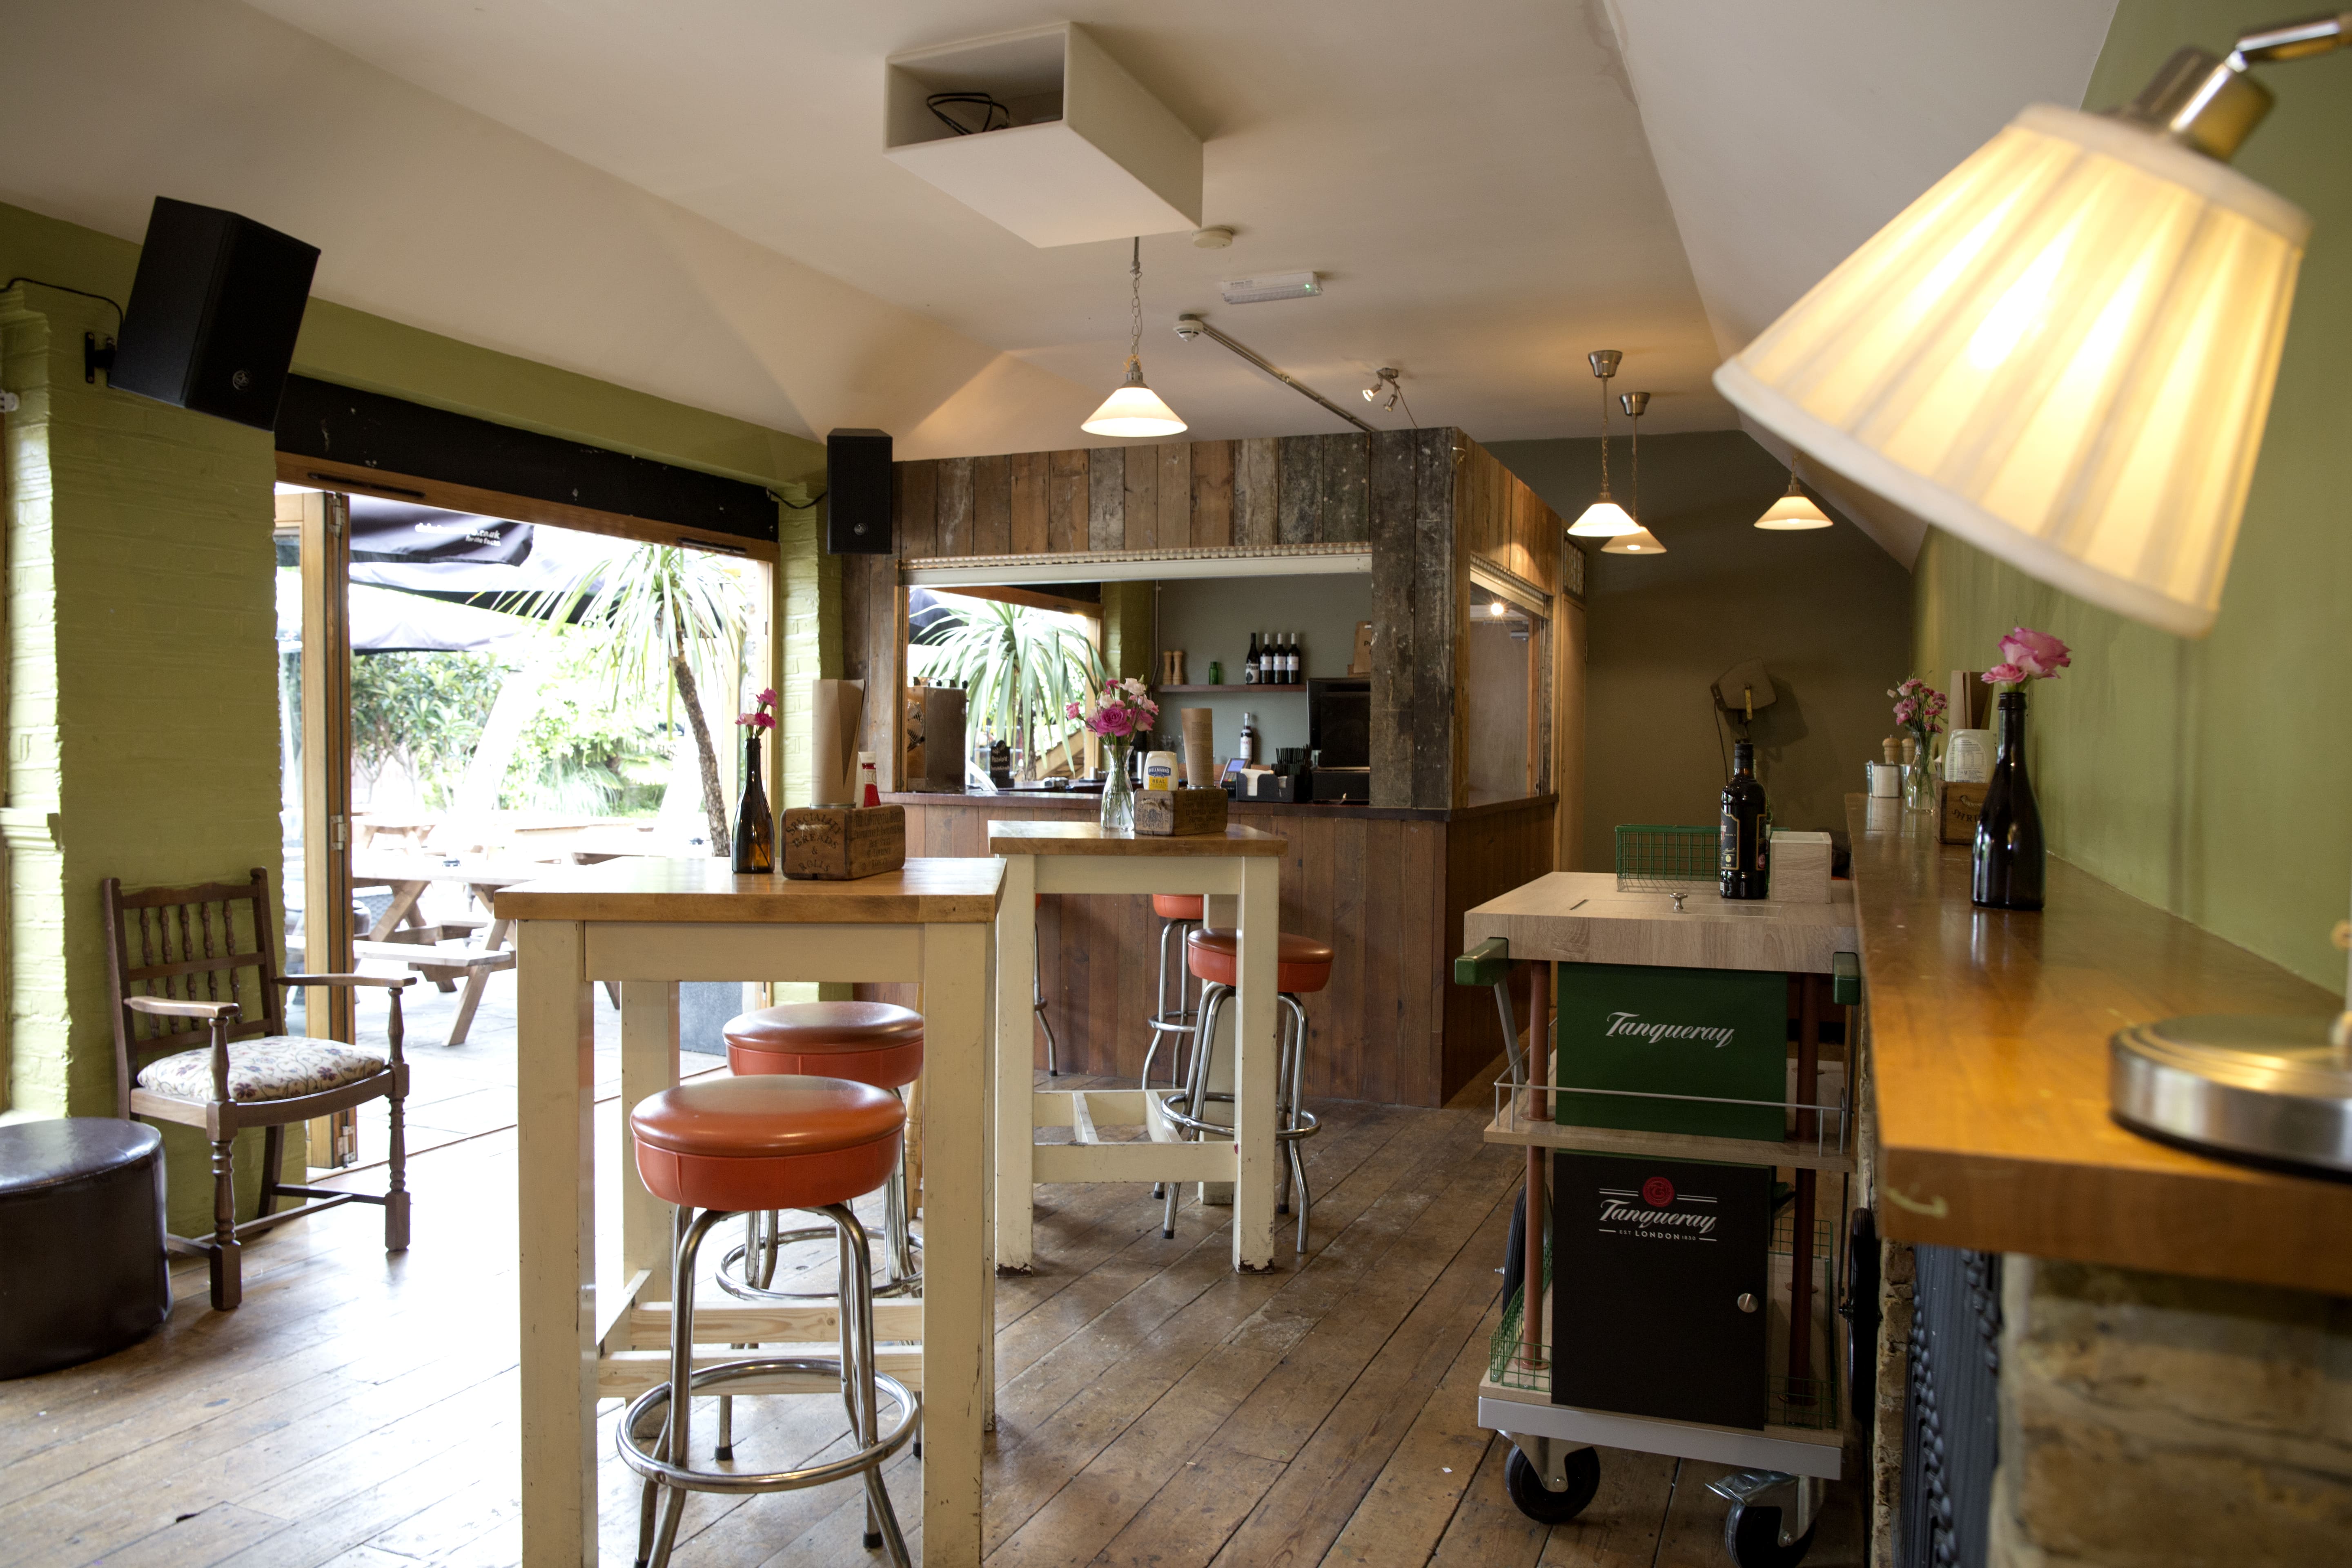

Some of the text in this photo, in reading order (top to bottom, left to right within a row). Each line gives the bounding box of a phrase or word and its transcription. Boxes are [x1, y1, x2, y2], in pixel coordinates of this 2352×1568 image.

[792, 833, 838, 849] BREADS
[812, 846, 818, 855] &
[798, 860, 830, 872] ROLLS
[1605, 1011, 1735, 1048] Tanqueray
[1599, 1199, 1717, 1234] Tanqueray
[1635, 1230, 1680, 1240] LONDON
